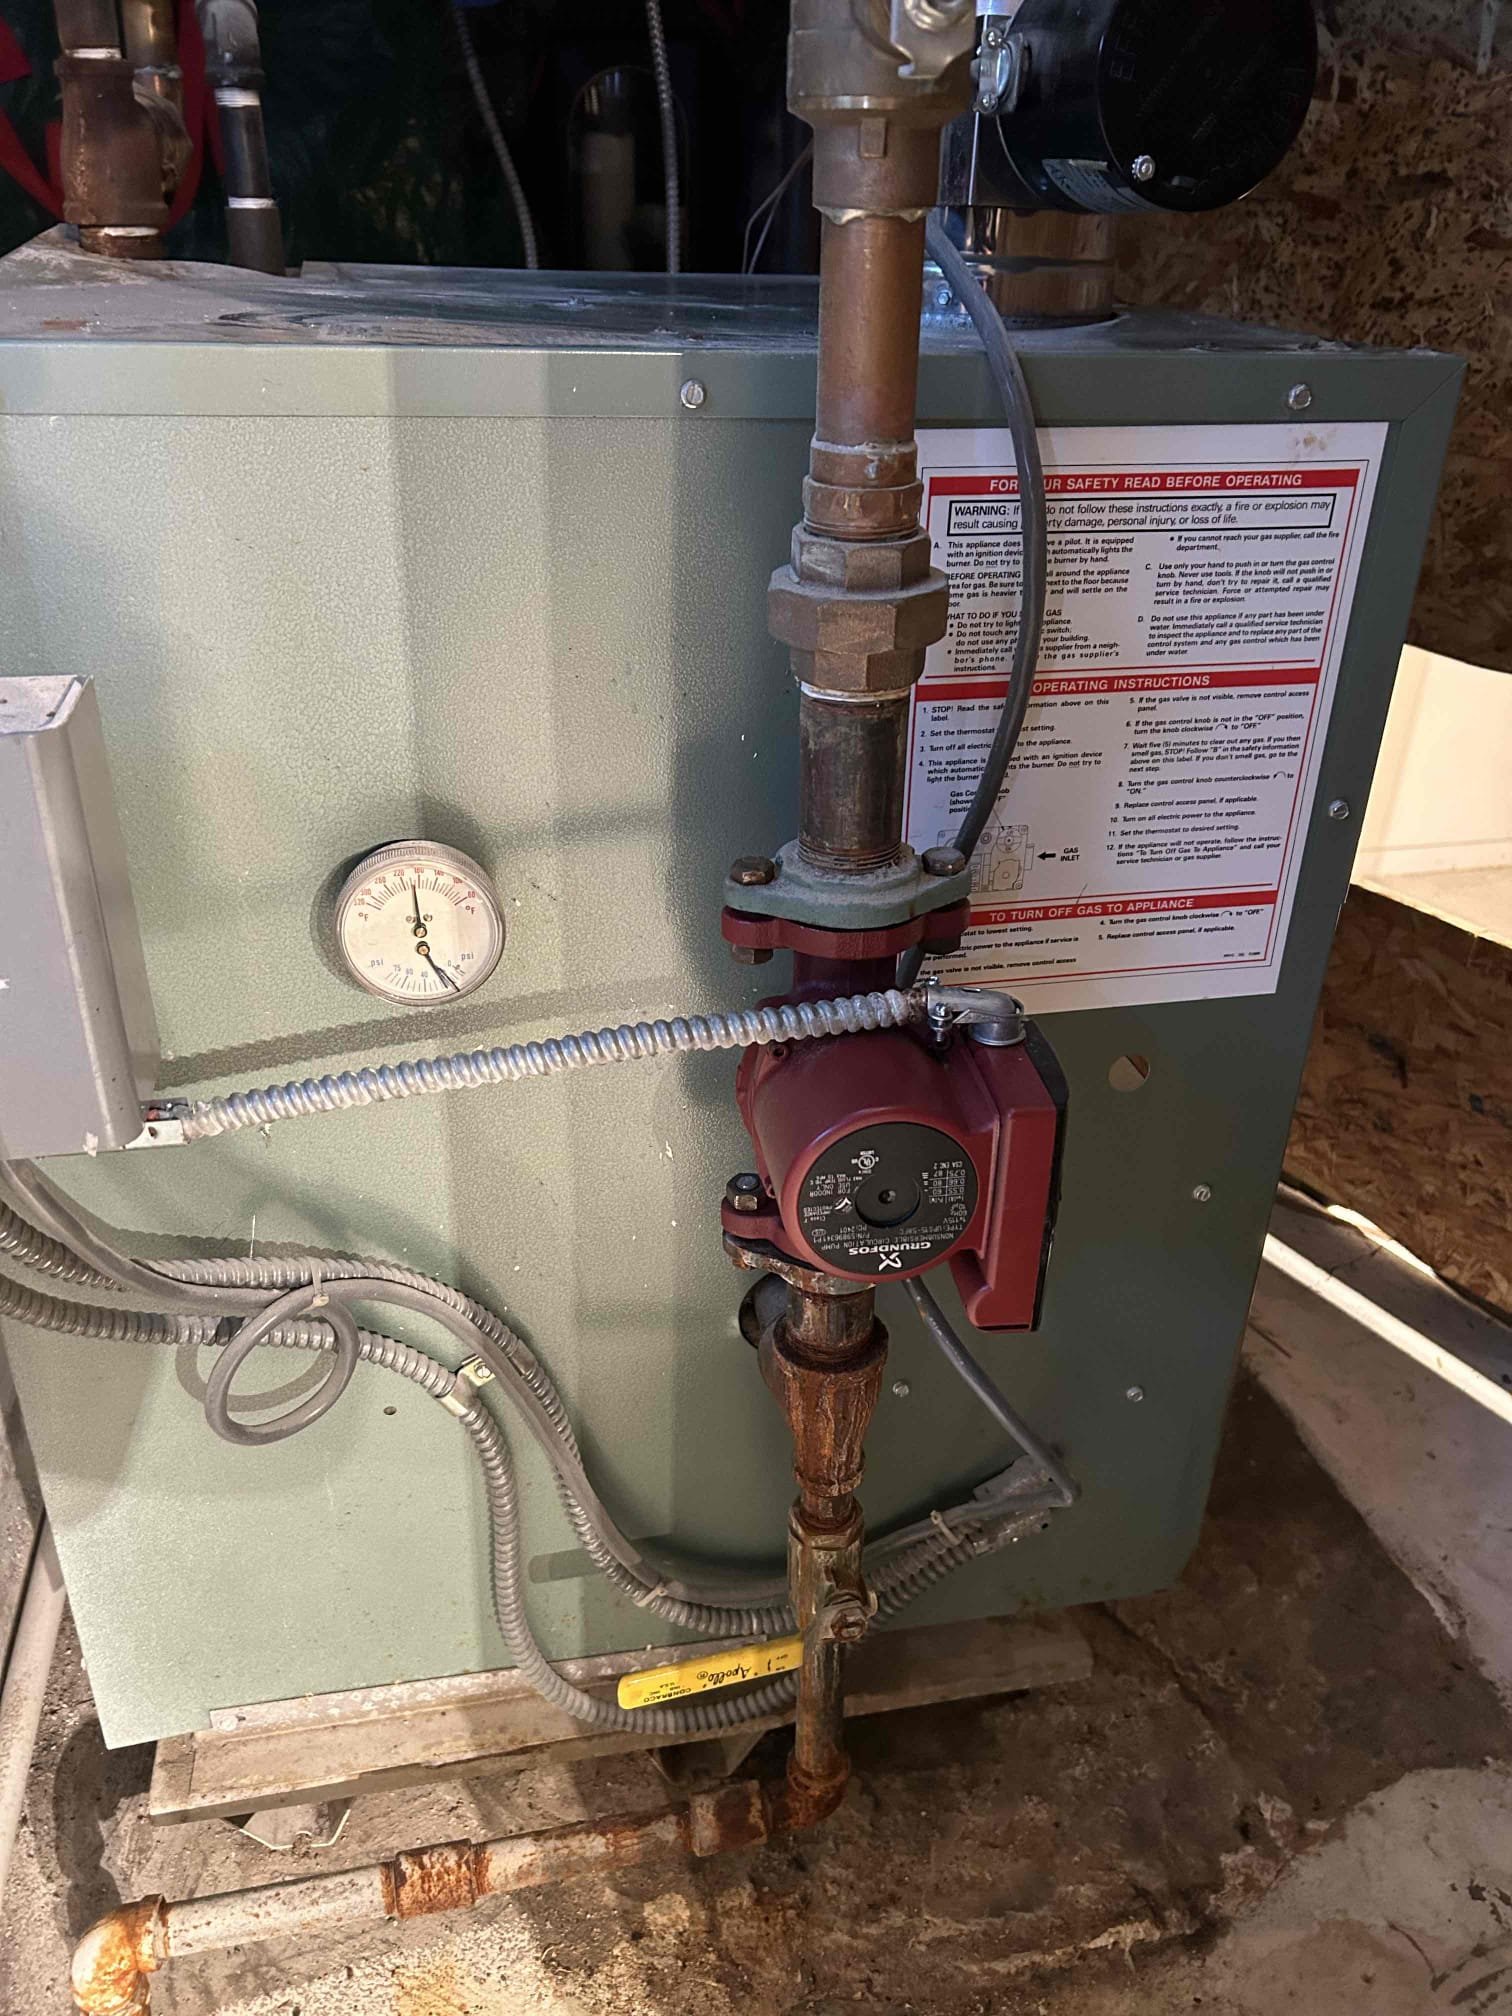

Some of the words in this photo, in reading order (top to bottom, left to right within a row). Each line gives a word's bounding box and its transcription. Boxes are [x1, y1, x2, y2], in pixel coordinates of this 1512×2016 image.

[989, 479, 1019, 491] FOR
[1066, 477, 1117, 489] SAFETY
[1124, 477, 1160, 488] READ
[1166, 476, 1219, 488] BEFORE
[1225, 474, 1302, 487] OPERATING
[954, 506, 1010, 516] WARNING:
[1013, 505, 1020, 515] If
[1057, 504, 1074, 514] not
[1077, 504, 1105, 513] follow
[1108, 503, 1133, 513] these
[1136, 503, 1188, 513] instructions
[1190, 502, 1222, 514] exactly,
[1234, 502, 1249, 511] fire
[1252, 503, 1261, 511] or
[1264, 501, 1307, 513] explosion
[1310, 502, 1330, 512] may
[953, 519, 979, 528] result
[981, 518, 1018, 530] causing
[1064, 517, 1104, 529] damage,
[1107, 516, 1147, 528] personal
[1149, 515, 1176, 527] injury,
[1191, 515, 1209, 524] loss
[1211, 515, 1220, 524] of
[1223, 514, 1238, 524] life.
[948, 541, 963, 549] This
[966, 540, 1000, 550] appliance
[1064, 538, 1080, 547] pilot.
[1084, 537, 1090, 545] It
[1092, 537, 1098, 545] is
[1101, 536, 1135, 546] equipped
[1183, 536, 1196, 544] you
[1197, 534, 1221, 542] cannot
[1223, 533, 1241, 541] reach
[1243, 534, 1258, 542] your
[1260, 534, 1272, 542] gas
[1273, 532, 1301, 541] supplier,
[1303, 531, 1315, 539] call
[1328, 530, 1340, 538] fire
[947, 550, 963, 558] with
[975, 549, 1002, 559] ignition
[1051, 546, 1099, 556] automatically
[1100, 545, 1119, 555] lights
[1176, 542, 1219, 552] department.
[946, 559, 970, 567] burner.
[999, 558, 1010, 568] try
[1053, 556, 1076, 564] burner
[1079, 556, 1087, 565] by
[1090, 555, 1109, 563] hand.
[1158, 562, 1172, 570] Use
[1173, 562, 1188, 571] only
[1190, 562, 1205, 570] your
[1207, 560, 1225, 568] hand
[1226, 560, 1233, 568] to
[1234, 560, 1251, 569] push
[1252, 559, 1259, 567] in
[1285, 558, 1296, 566] the
[1297, 559, 1309, 567] gas
[1310, 557, 1335, 565] control
[949, 572, 974, 580] EFORE
[977, 571, 1021, 580] OPERATING
[1055, 569, 1080, 577] around
[1082, 568, 1094, 576] the
[1096, 567, 1130, 577] appliance
[1032, 679, 1107, 693] OPERATING
[1113, 675, 1210, 689] INSTRUCTIONS
[929, 729, 941, 737] Set
[943, 728, 954, 736] the
[956, 726, 996, 735] thermostat
[1030, 723, 1056, 733] setting.
[1122, 814, 1136, 822] Turn
[1147, 813, 1155, 821] all
[1157, 812, 1180, 820] electric
[1181, 812, 1202, 821] power
[1204, 810, 1211, 818] to
[1224, 808, 1256, 819] appliance.
[1063, 846, 1079, 854] GAS
[1060, 853, 1081, 862] INLET
[989, 912, 1005, 922] TO
[1012, 909, 1043, 921] TURN
[1048, 907, 1071, 918] OFF
[1076, 905, 1101, 916] GAS
[1107, 903, 1122, 914] TO
[1126, 898, 1195, 912] APPLIANCE
[461, 952, 474, 961] psi
[371, 960, 383, 968] psi
[843, 1238, 889, 1248] CIRCULATION
[894, 1233, 954, 1243] NONSUBMERSIBLE
[849, 1242, 931, 1255] GRUNDFOS
[643, 1688, 691, 1703] CONBRACO
